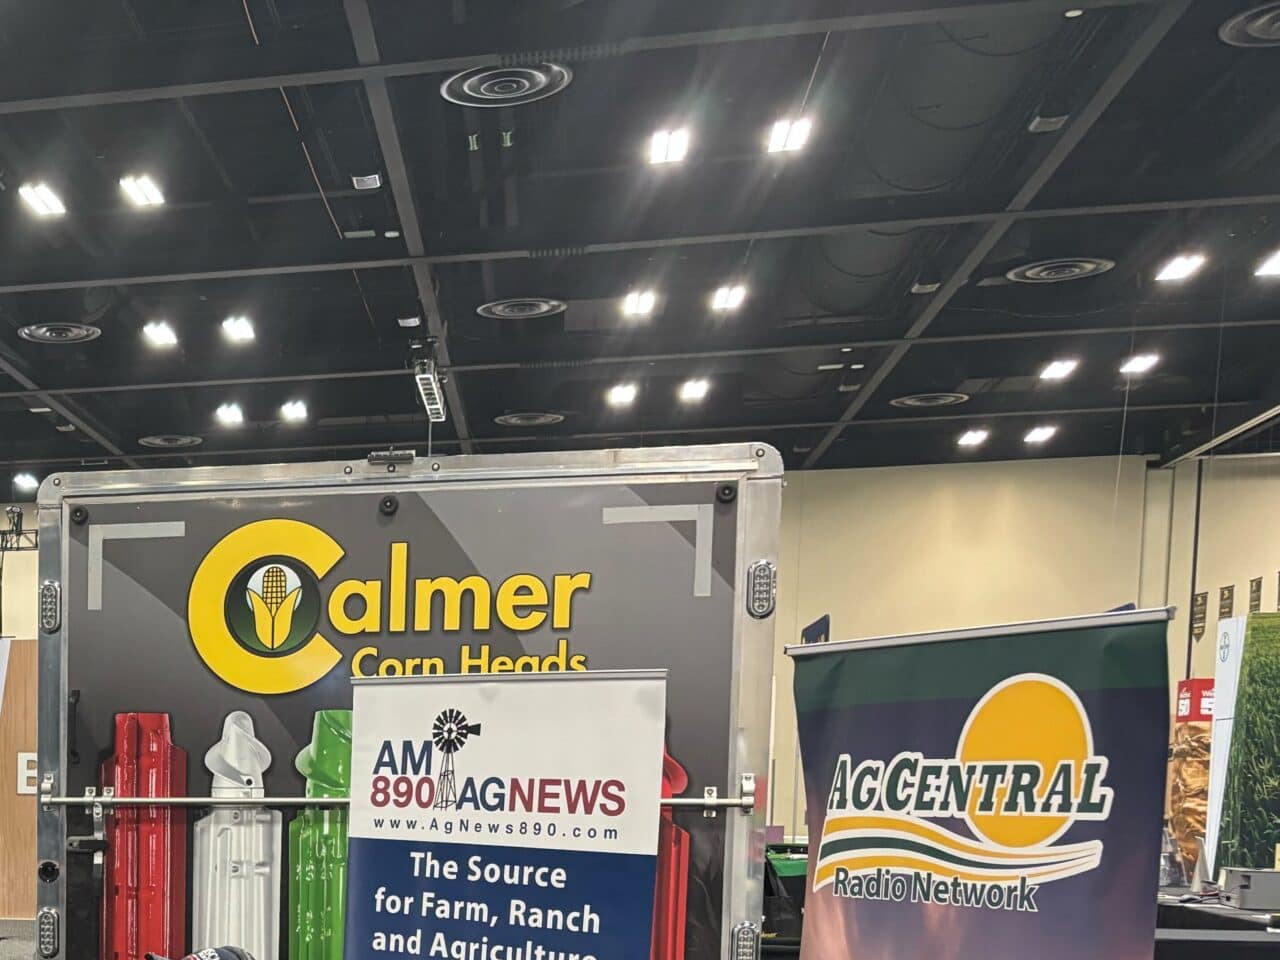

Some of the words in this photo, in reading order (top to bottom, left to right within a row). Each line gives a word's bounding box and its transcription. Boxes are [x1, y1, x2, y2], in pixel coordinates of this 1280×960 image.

[188, 518, 592, 695] Calmer
[351, 646, 444, 677] Corn
[461, 640, 587, 674] Heads
[373, 740, 433, 776] AM
[370, 776, 435, 809] 890
[456, 776, 626, 817] AGNEWS
[373, 817, 619, 841] www.AgNews890.com
[410, 851, 459, 880] The
[467, 855, 567, 889] Source
[833, 867, 906, 901] Radio
[911, 871, 1040, 912] Network
[375, 886, 414, 914] for
[422, 892, 499, 928] Farm,
[509, 899, 600, 934] Ranch
[372, 929, 422, 956] and
